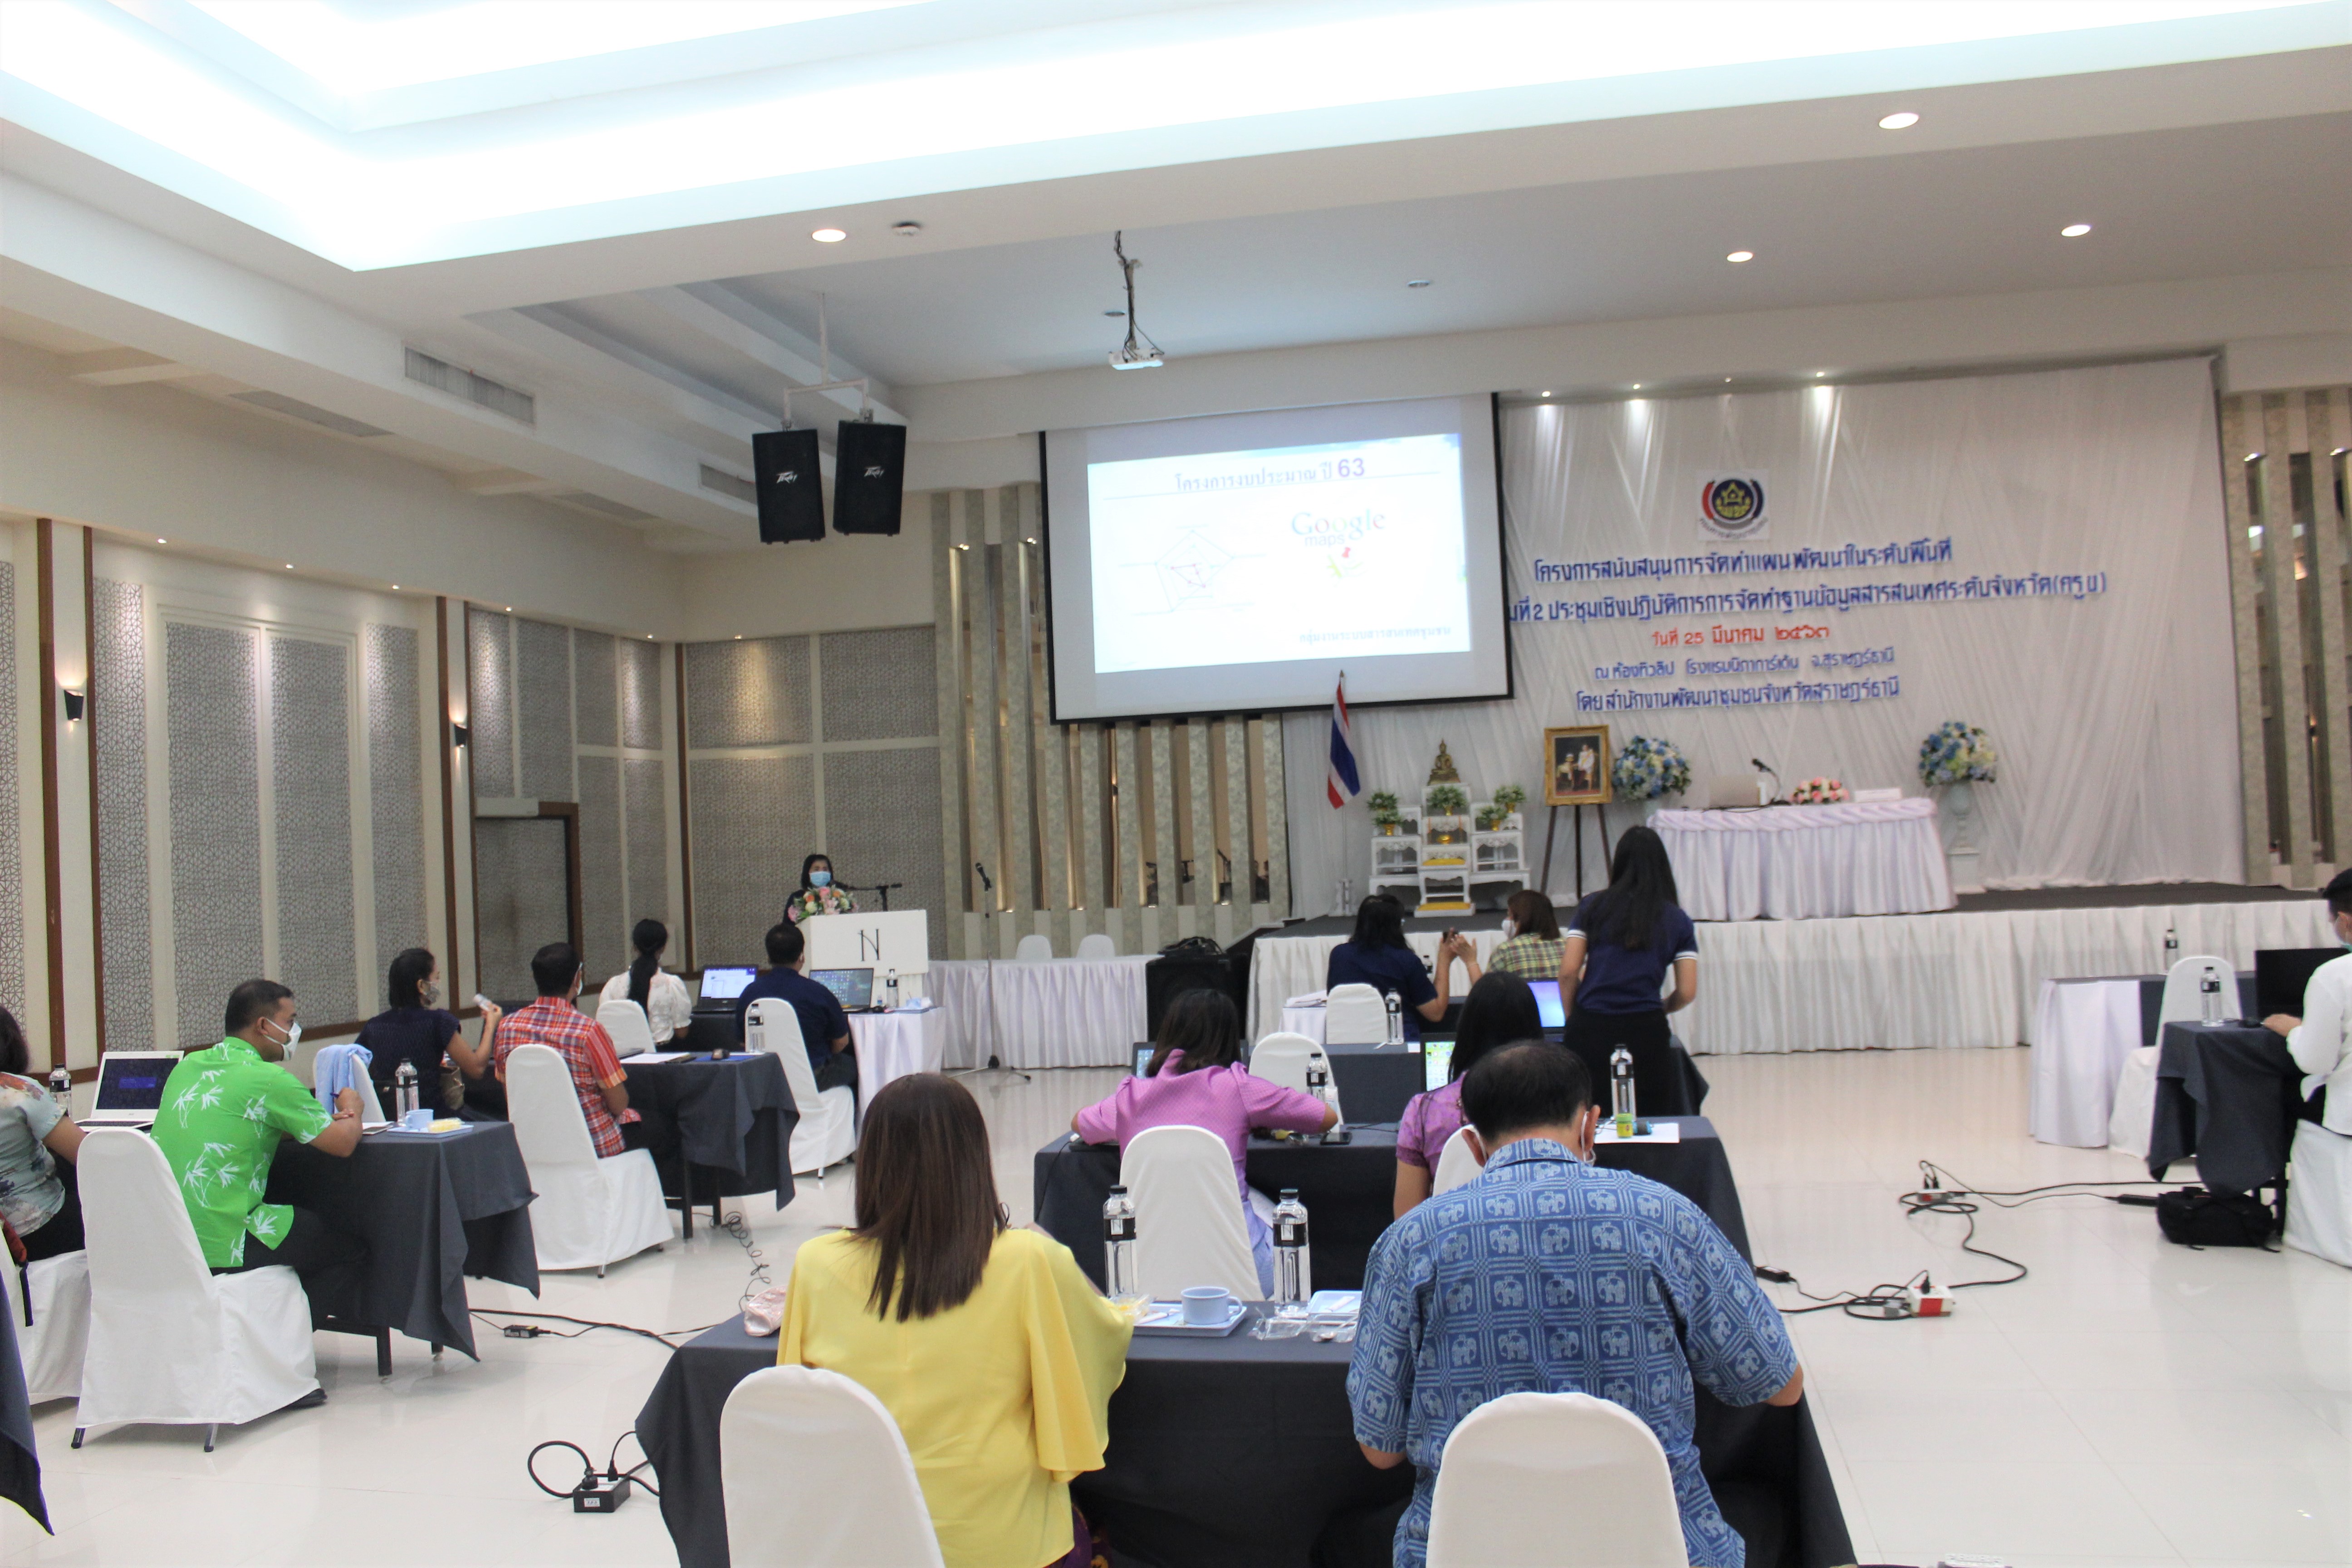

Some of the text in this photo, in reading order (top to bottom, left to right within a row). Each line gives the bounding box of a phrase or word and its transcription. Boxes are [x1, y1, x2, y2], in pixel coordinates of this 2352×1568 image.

[1175, 457, 1366, 491] โครงการงบประมาณ ปี 63
[1291, 508, 1386, 540] Google
[1305, 534, 1345, 548] maps
[1684, 632, 1705, 645] 25
[1712, 624, 1764, 644] มีนาคม
[1774, 624, 1829, 640] ๒๕๖๓
[858, 928, 880, 961] N
